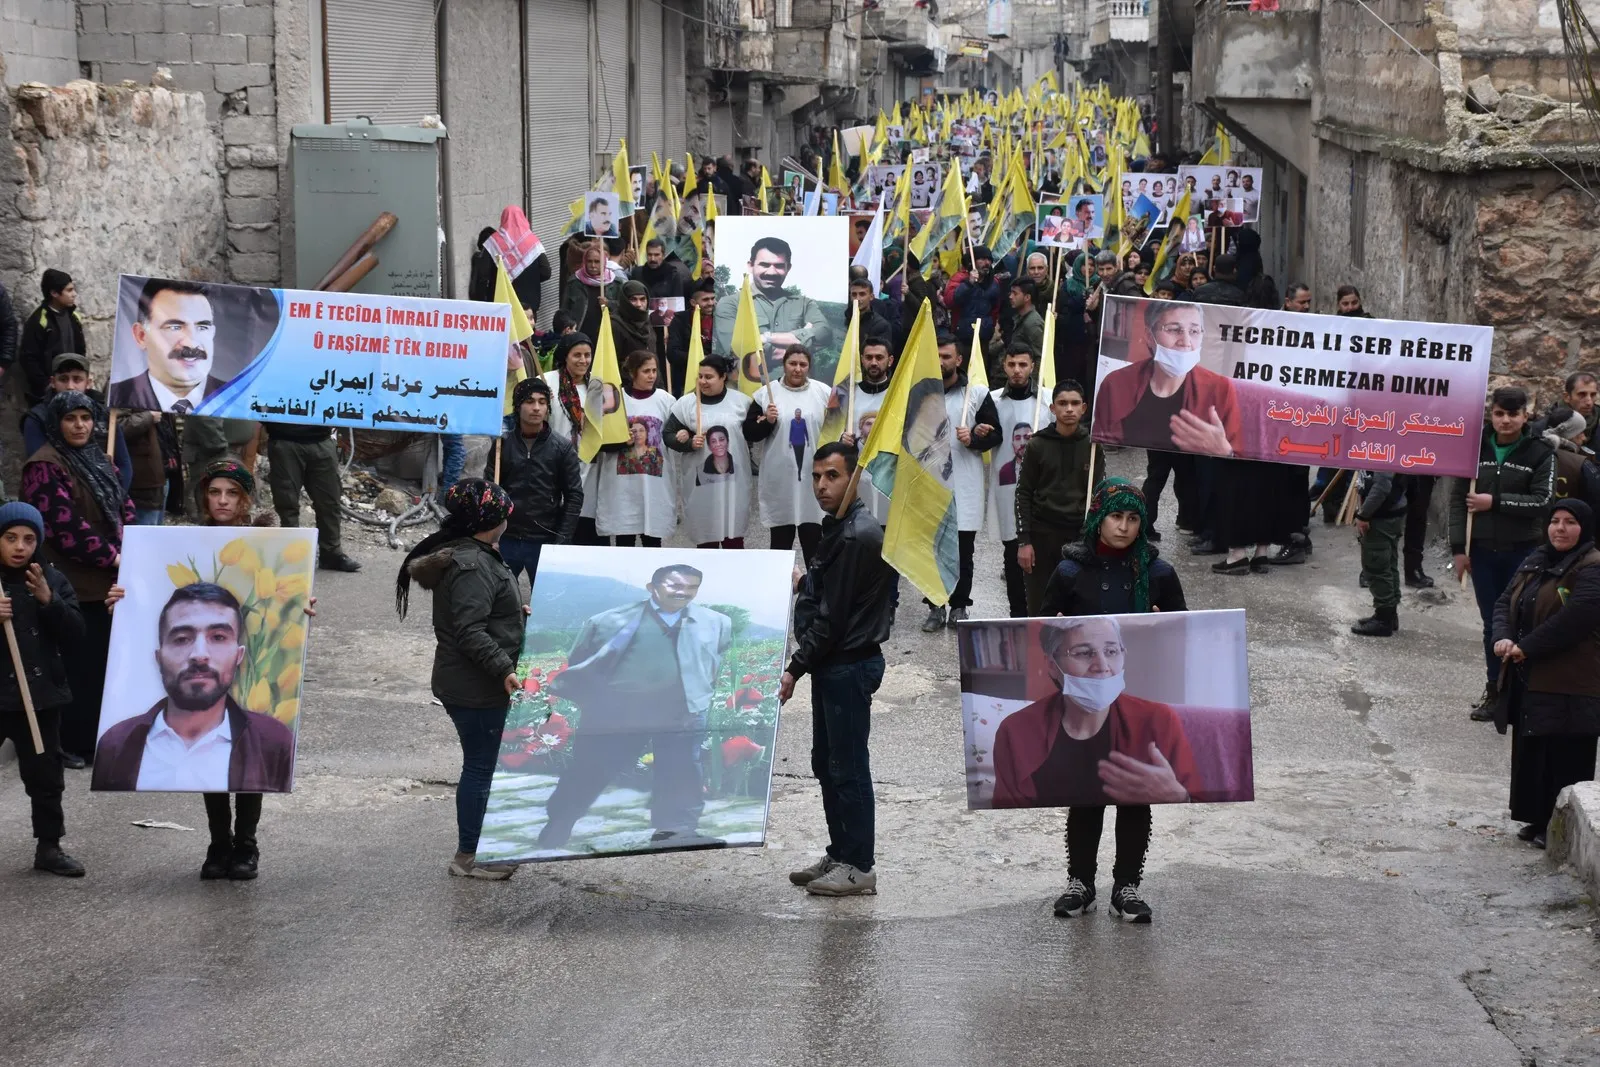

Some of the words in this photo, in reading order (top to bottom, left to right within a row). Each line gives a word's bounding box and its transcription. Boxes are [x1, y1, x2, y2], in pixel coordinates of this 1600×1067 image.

[289, 302, 311, 318] EM
[315, 301, 323, 319] Ê
[328, 304, 381, 323] TECÎDA
[386, 306, 440, 328] ÎMRALÎ
[443, 313, 506, 332] BIŞKNIN
[313, 331, 324, 349] Û
[328, 333, 390, 354] FAŞÎZMÊ
[394, 337, 421, 356] TÊK
[425, 341, 468, 359] BIBIN
[1219, 324, 1315, 349] TECRÎDA
[1323, 333, 1342, 351] LI
[1349, 335, 1392, 355] SER
[1400, 337, 1473, 362] RÊBER
[309, 369, 374, 396] إيمرالي
[381, 372, 422, 397] عزلة
[429, 378, 498, 399] سنكسر
[1233, 361, 1273, 382] APO
[1279, 366, 1385, 391] ŞERMEZAR
[1391, 375, 1449, 397] DIKIN
[250, 395, 315, 418] الفاشية
[323, 401, 363, 424] نظام
[372, 405, 448, 430] وسنحطم
[1267, 400, 1338, 427] المفروضة
[1342, 408, 1396, 432] العزلة
[1397, 412, 1465, 436] نستنكر
[1348, 441, 1396, 463] القائد
[1400, 447, 1436, 468] على
